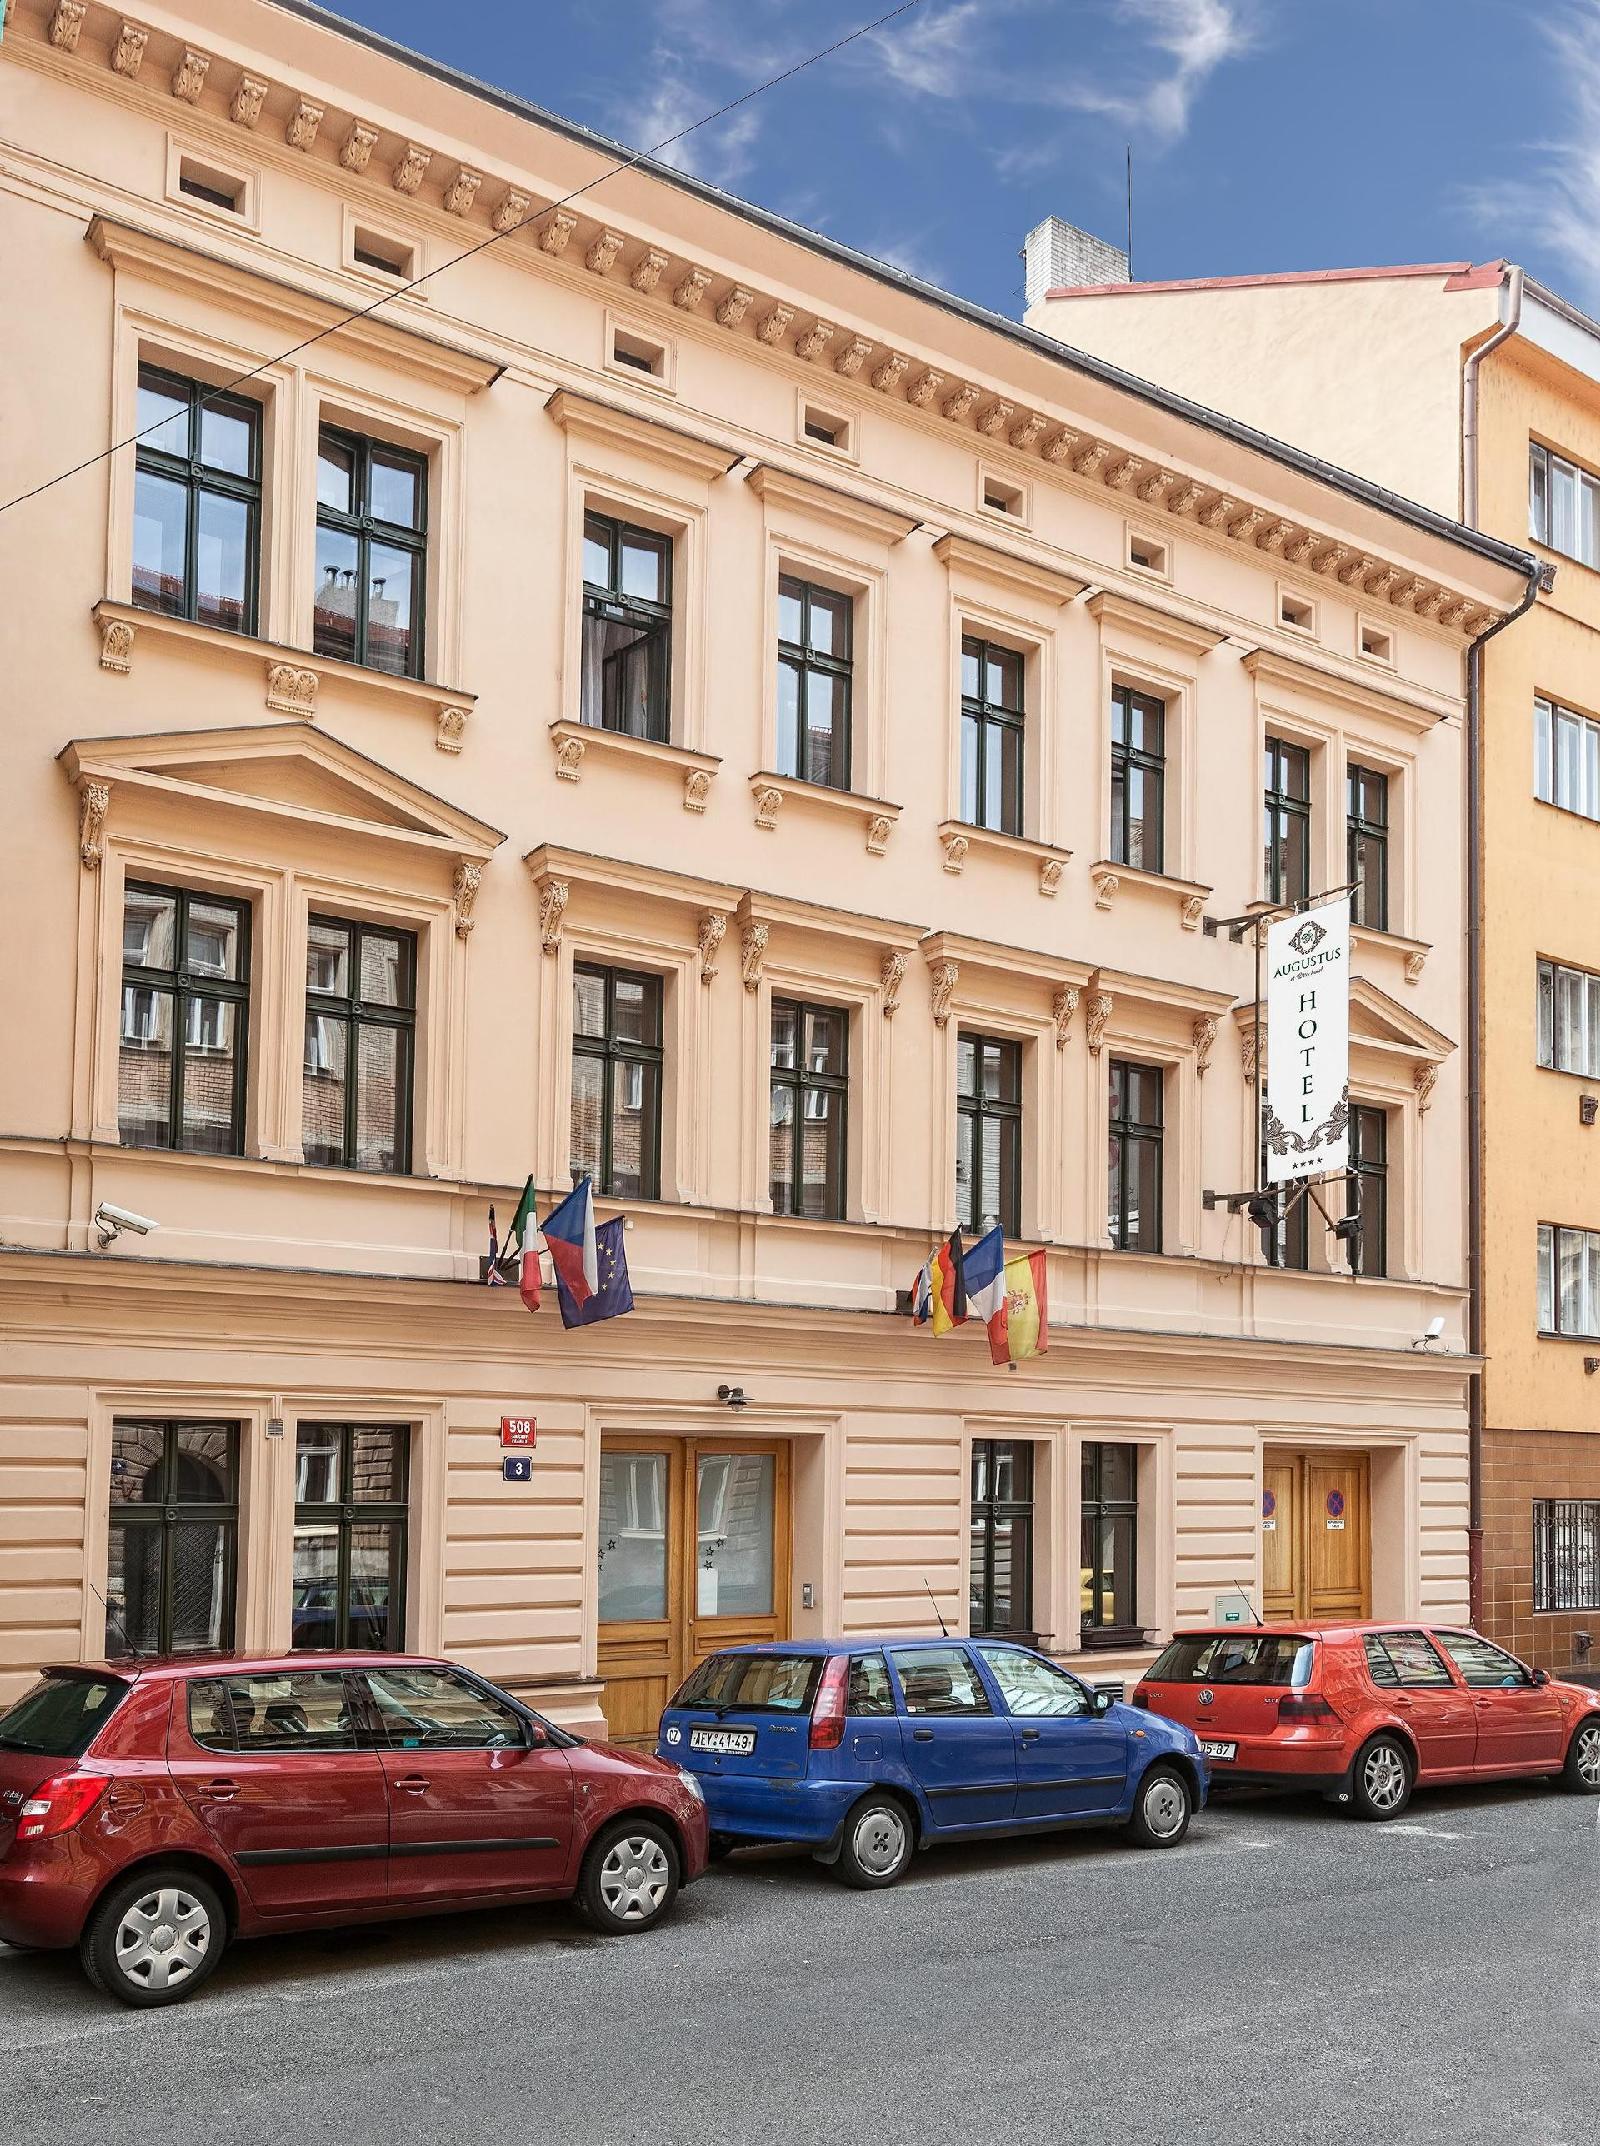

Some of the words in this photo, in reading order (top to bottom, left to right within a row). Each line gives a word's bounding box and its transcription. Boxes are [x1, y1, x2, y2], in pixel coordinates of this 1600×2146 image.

[1273, 947, 1341, 979] AUGUSTUS
[1298, 990, 1318, 1123] HOTEL
[509, 1420, 531, 1434] 508
[515, 1462, 523, 1475] 3
[669, 1729, 679, 1742] CZ
